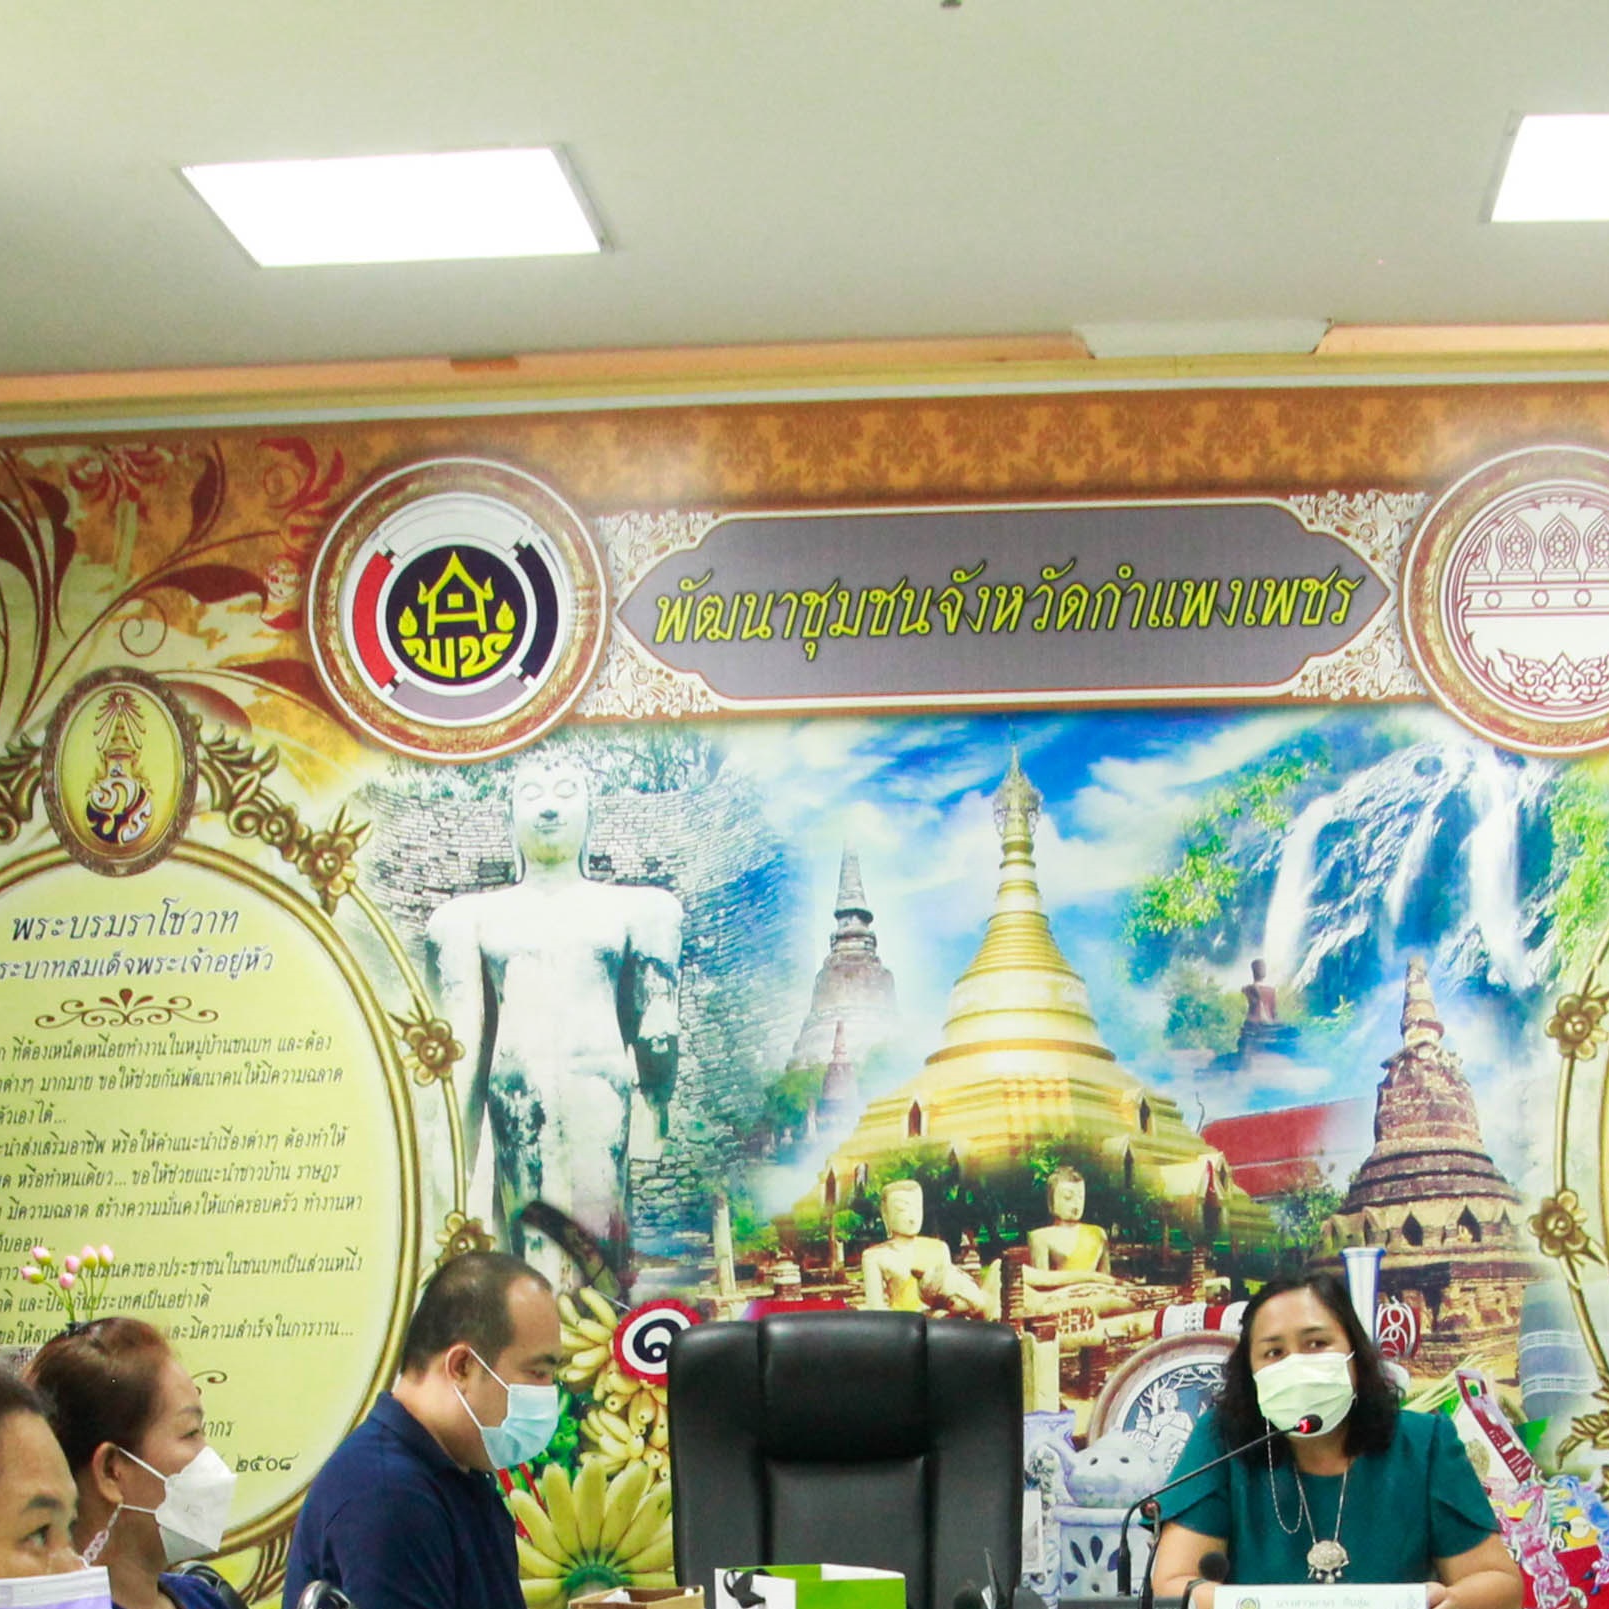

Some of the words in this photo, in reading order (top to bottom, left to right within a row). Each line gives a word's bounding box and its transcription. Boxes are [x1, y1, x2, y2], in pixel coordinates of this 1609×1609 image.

[654, 560, 1365, 660] พัฒนาชุมชนจังหวัดกำแพงเพชร
[12, 897, 239, 941] พระบรมราโชวาท
